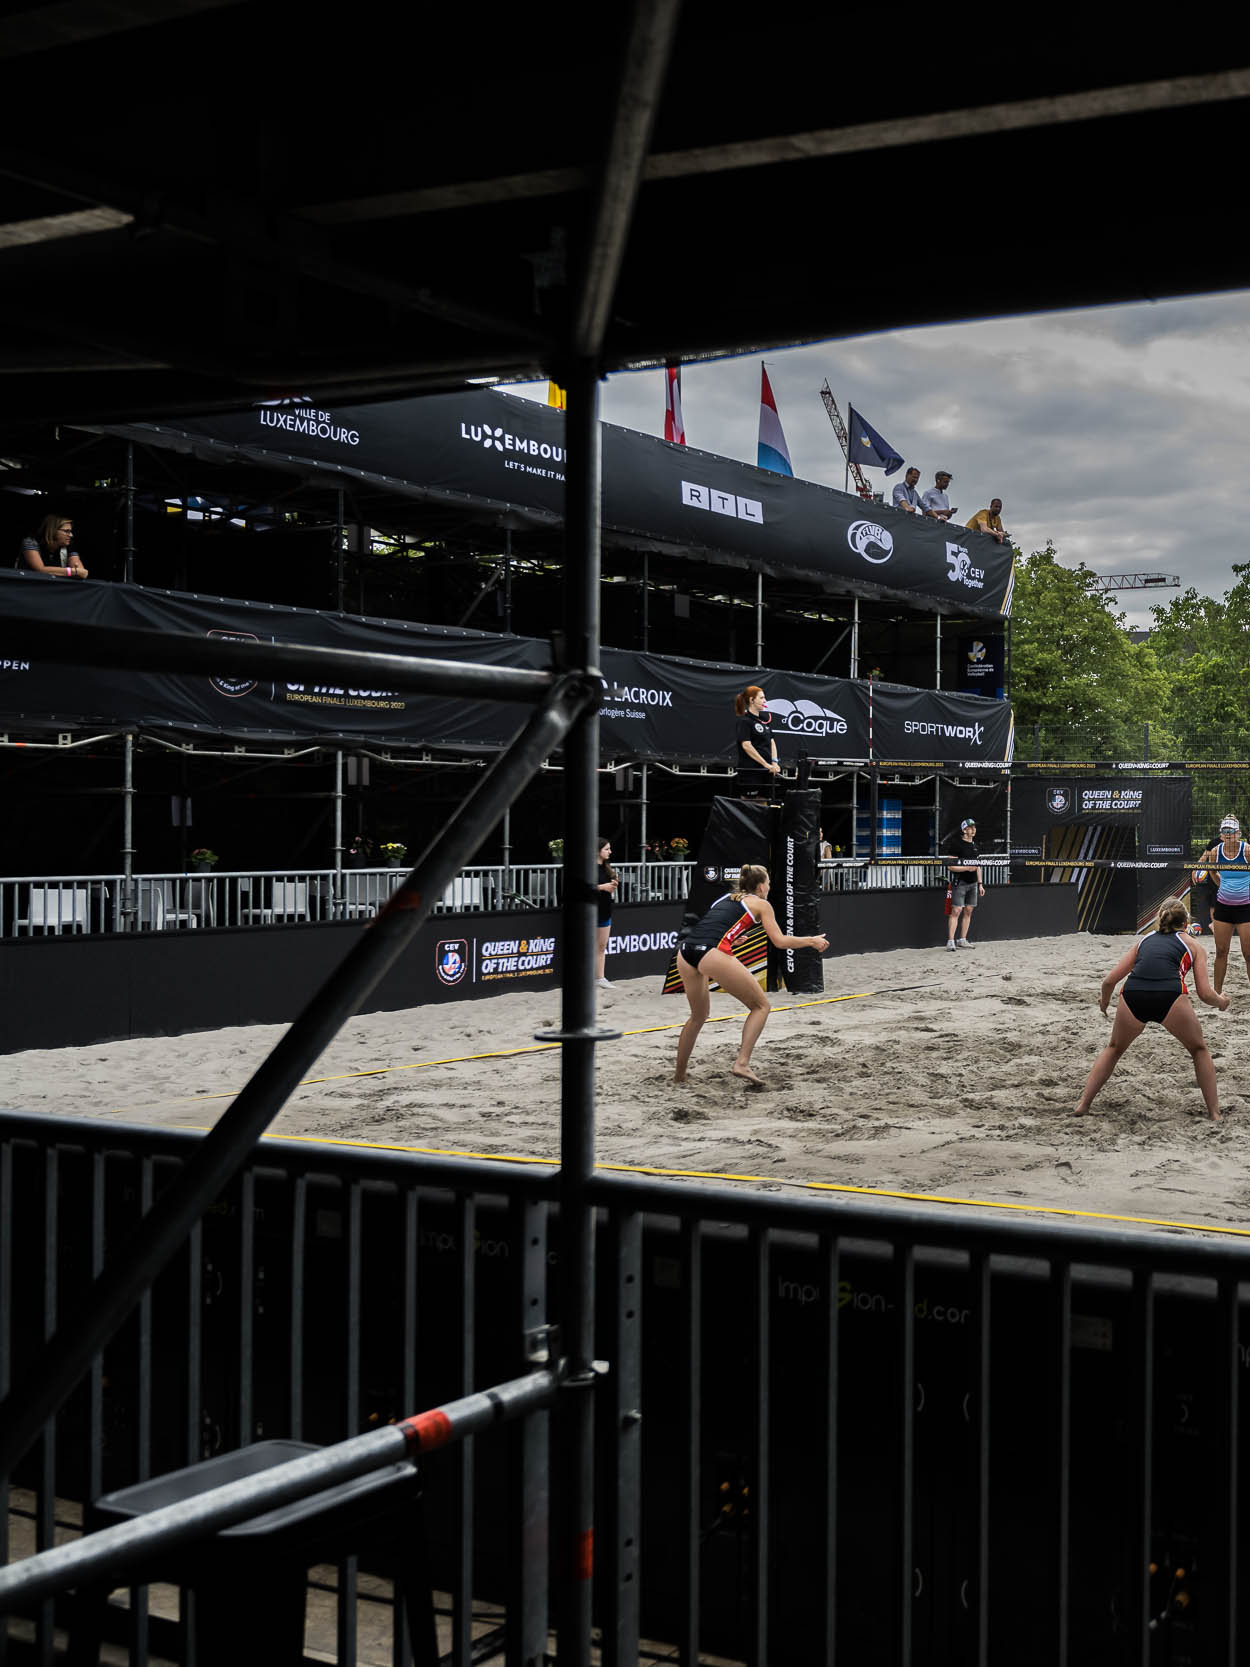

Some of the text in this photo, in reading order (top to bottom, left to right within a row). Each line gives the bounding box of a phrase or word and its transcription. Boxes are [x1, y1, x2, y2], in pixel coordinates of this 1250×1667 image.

[294, 407, 331, 423] VILLE DE
[260, 410, 360, 446] LUXEMBOURG
[504, 460, 526, 472] LET'S
[526, 465, 548, 478] MAKE
[548, 470, 557, 481] IT
[690, 487, 756, 518] RTL
[970, 567, 985, 579] CEV
[286, 692, 322, 705] EUROPEAN
[322, 696, 346, 707] FINALS
[346, 697, 390, 709] LUXEMBOURG
[625, 708, 647, 720] Suisse
[1082, 789, 1143, 799] QUEEN & KING
[1082, 800, 1141, 809] OF THE COURT
[786, 836, 796, 867] COURT
[786, 866, 795, 885] THE
[786, 895, 795, 918] KING
[444, 943, 460, 951] CEV
[482, 937, 557, 957] QUEEN & KING
[482, 953, 556, 974] OF THE COURT
